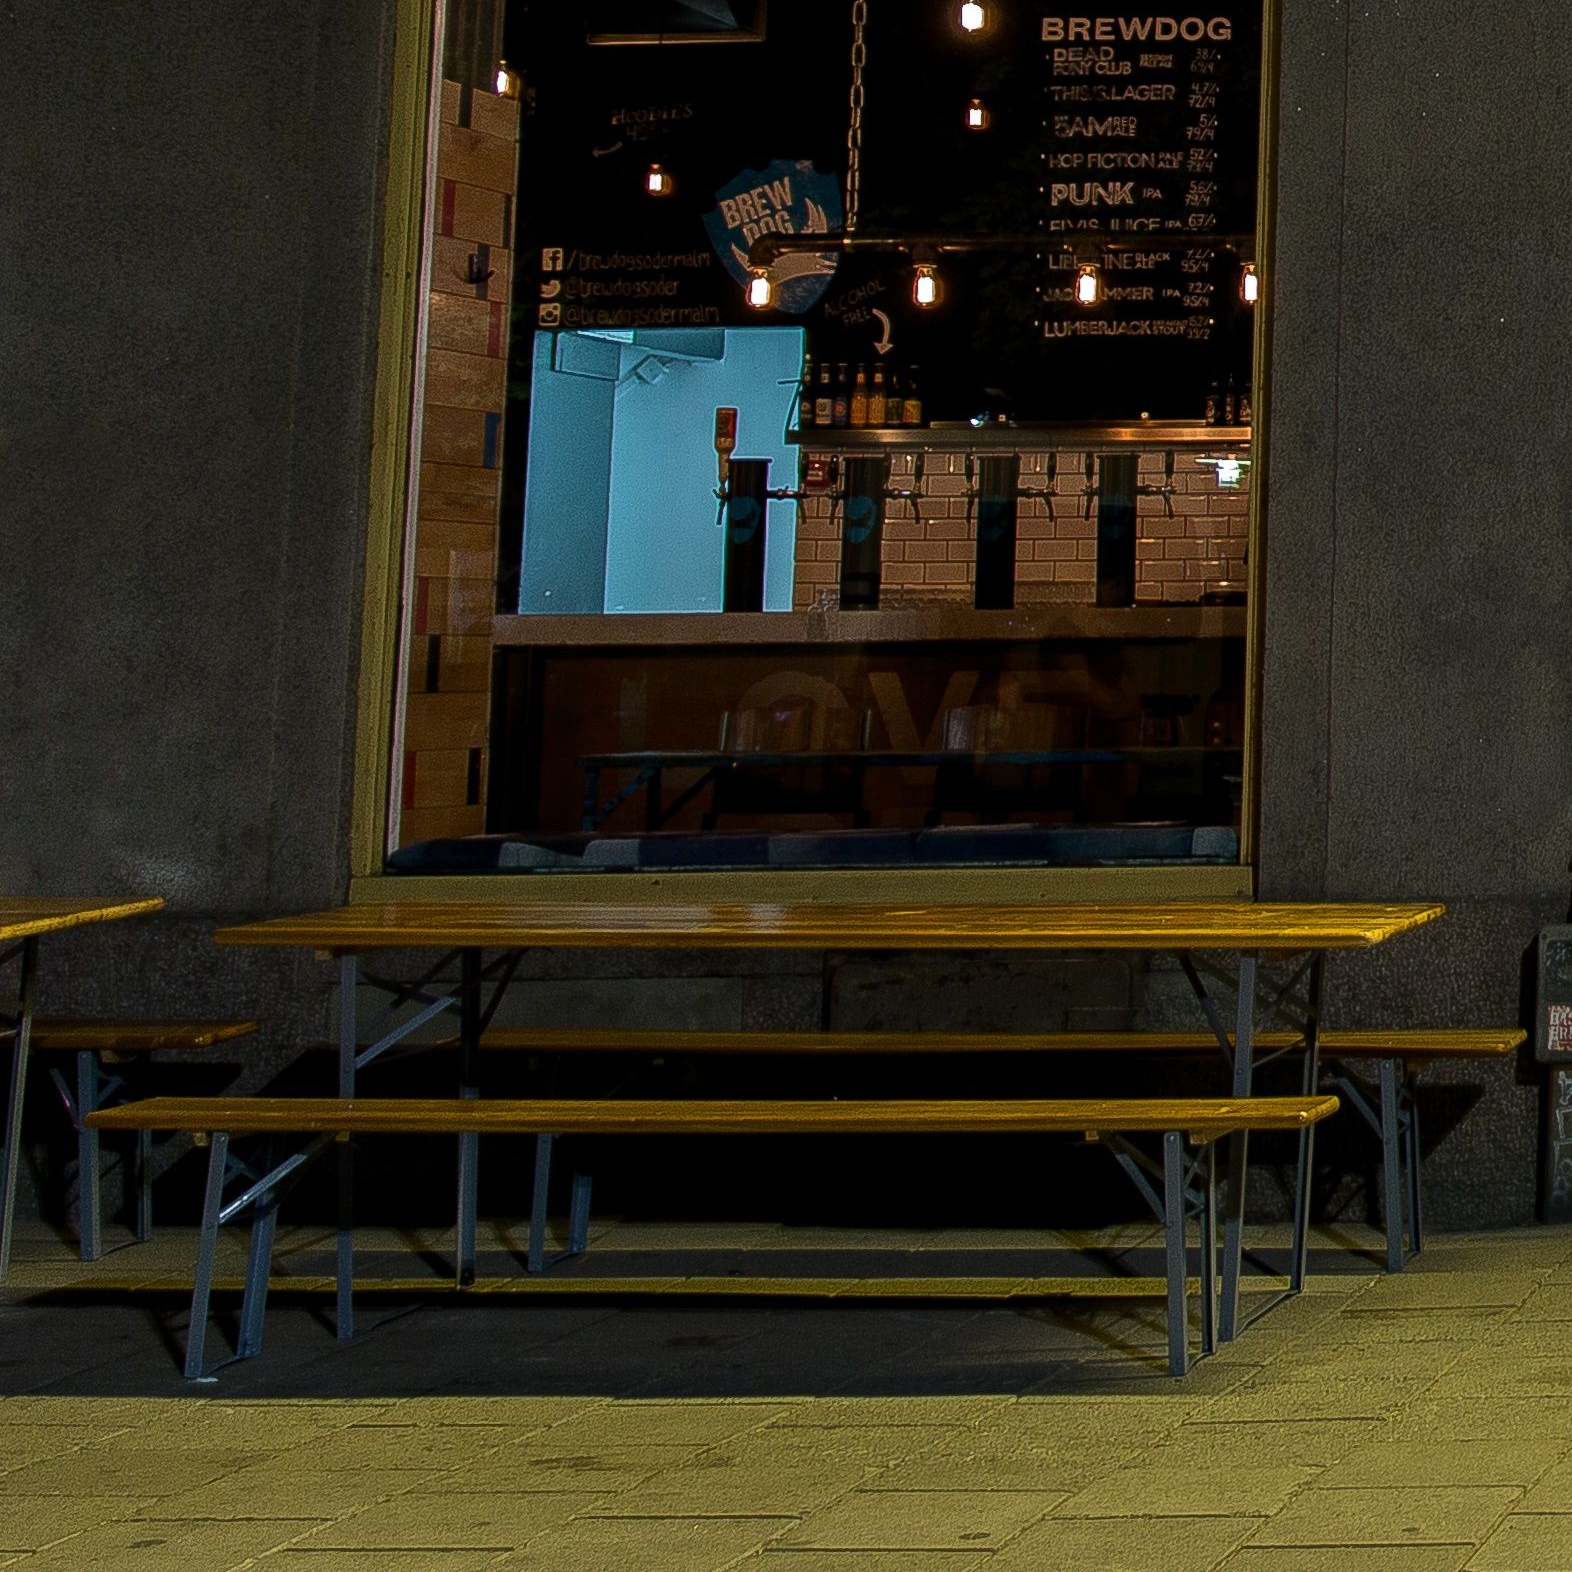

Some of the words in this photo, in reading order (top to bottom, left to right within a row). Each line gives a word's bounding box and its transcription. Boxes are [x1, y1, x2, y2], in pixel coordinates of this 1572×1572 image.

[1041, 17, 1233, 42] BREWDOG
[1053, 46, 1115, 61] DEAD
[1053, 62, 1092, 76] PONY
[1095, 61, 1132, 75] CLUB
[1111, 84, 1176, 101] LAGER
[1049, 153, 1085, 169] HOP
[1087, 152, 1156, 169] FICTION
[1050, 181, 1135, 206] PUNK
[1142, 187, 1164, 200] IPA
[719, 176, 793, 230] BREW
[1048, 252, 1134, 270] LIBINE
[823, 278, 886, 321] ALCOHOL
[1042, 286, 1154, 303] JACMMER
[1044, 321, 1151, 339] LUMBERJACK
